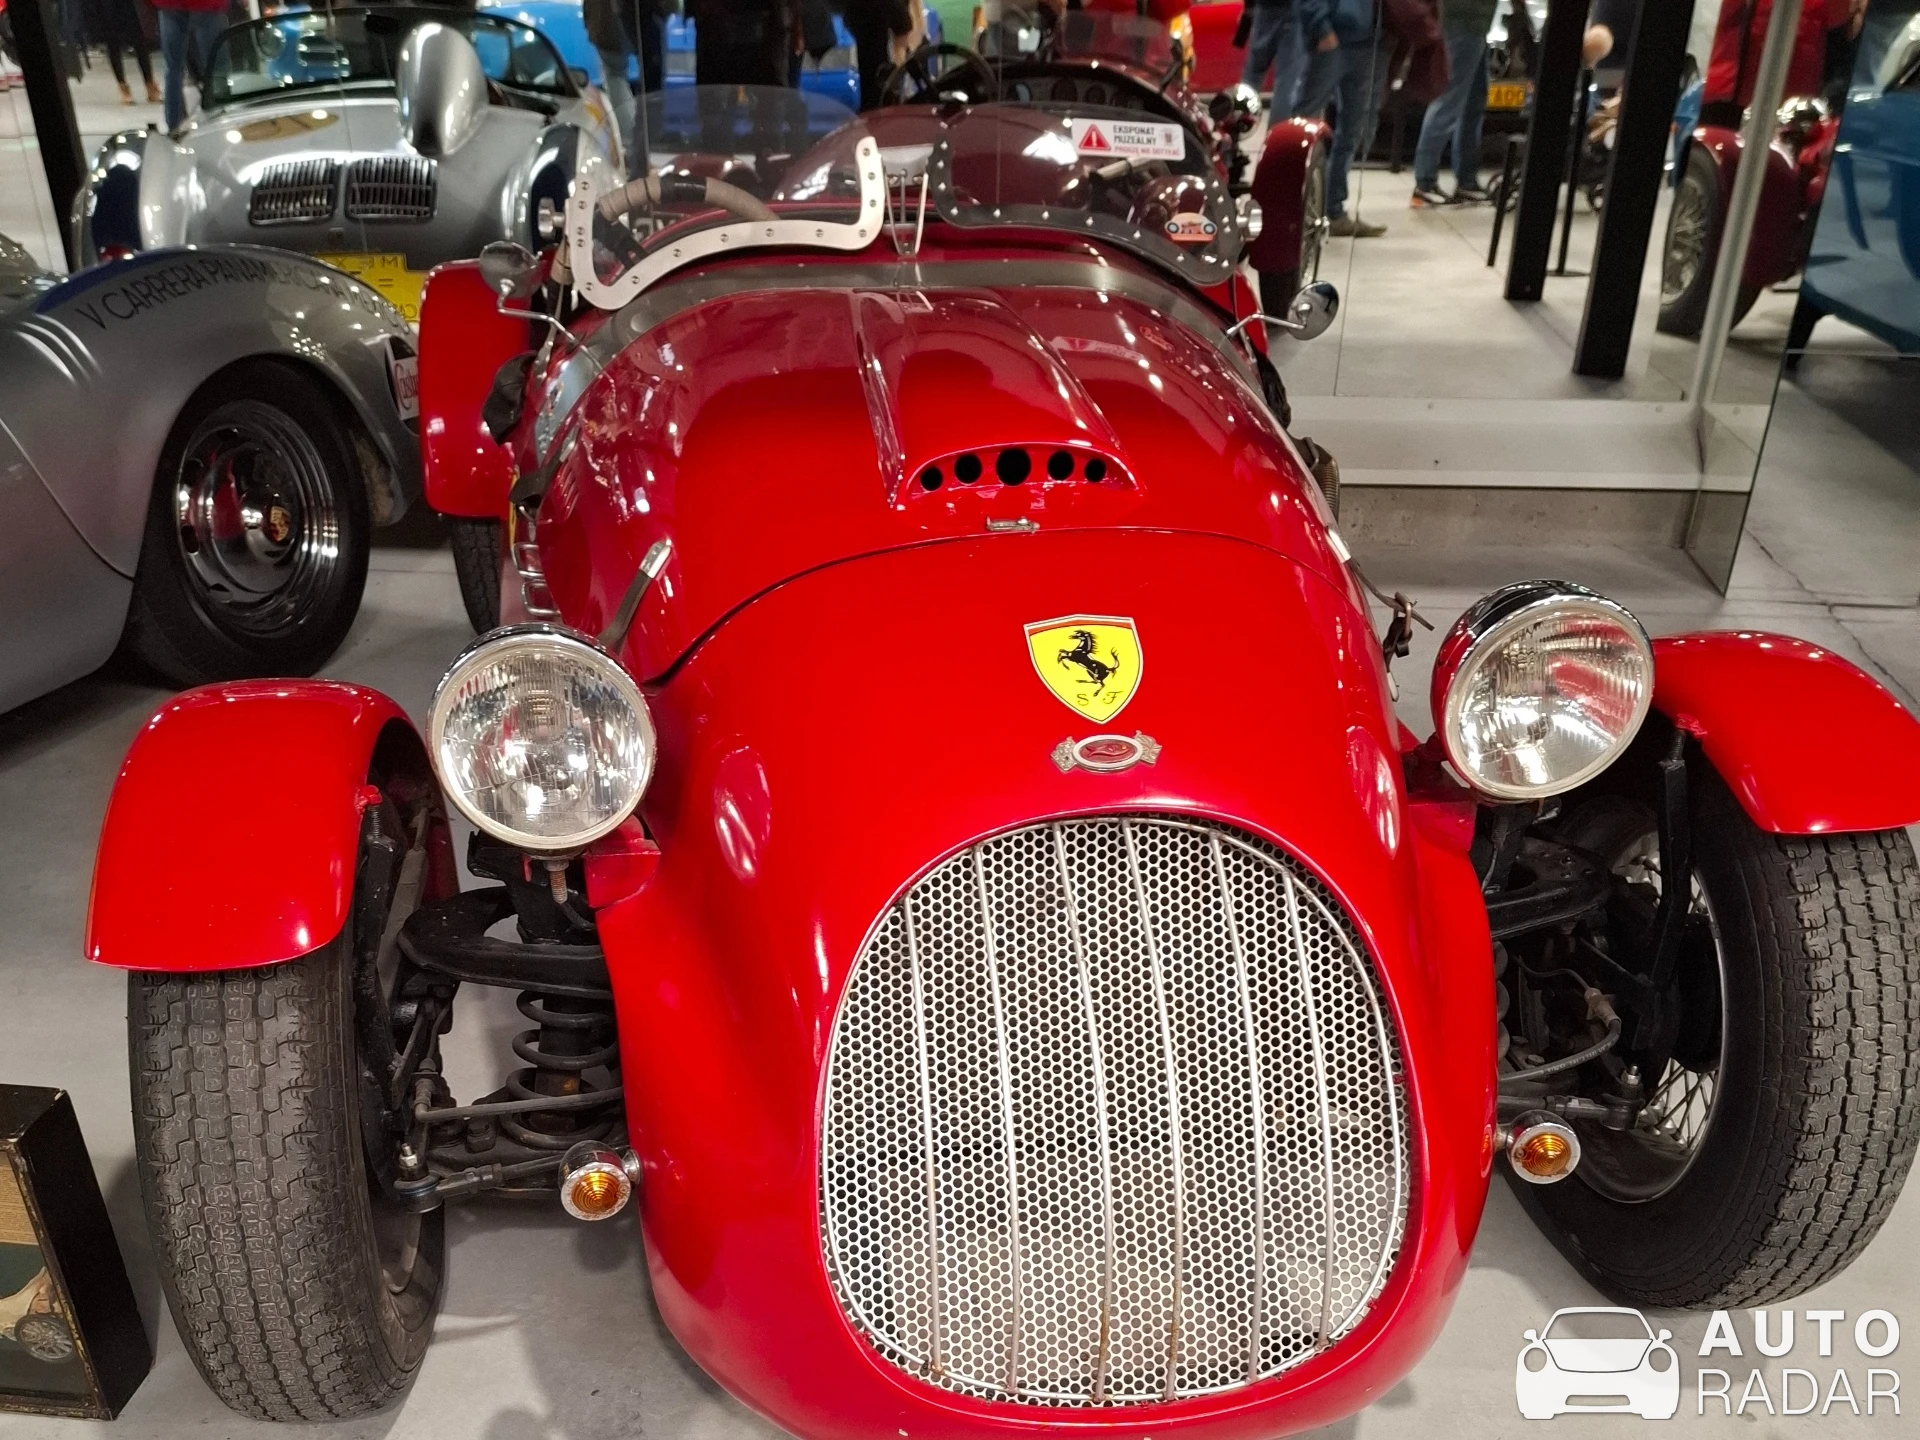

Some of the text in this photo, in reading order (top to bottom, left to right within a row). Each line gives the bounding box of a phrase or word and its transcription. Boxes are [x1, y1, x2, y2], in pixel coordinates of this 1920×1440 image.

[1112, 125, 1155, 135] EKSPONAT
[1114, 135, 1157, 145] MUZEALNY
[75, 304, 107, 330] V
[102, 264, 211, 320] CARRERA
[1076, 693, 1090, 706] S
